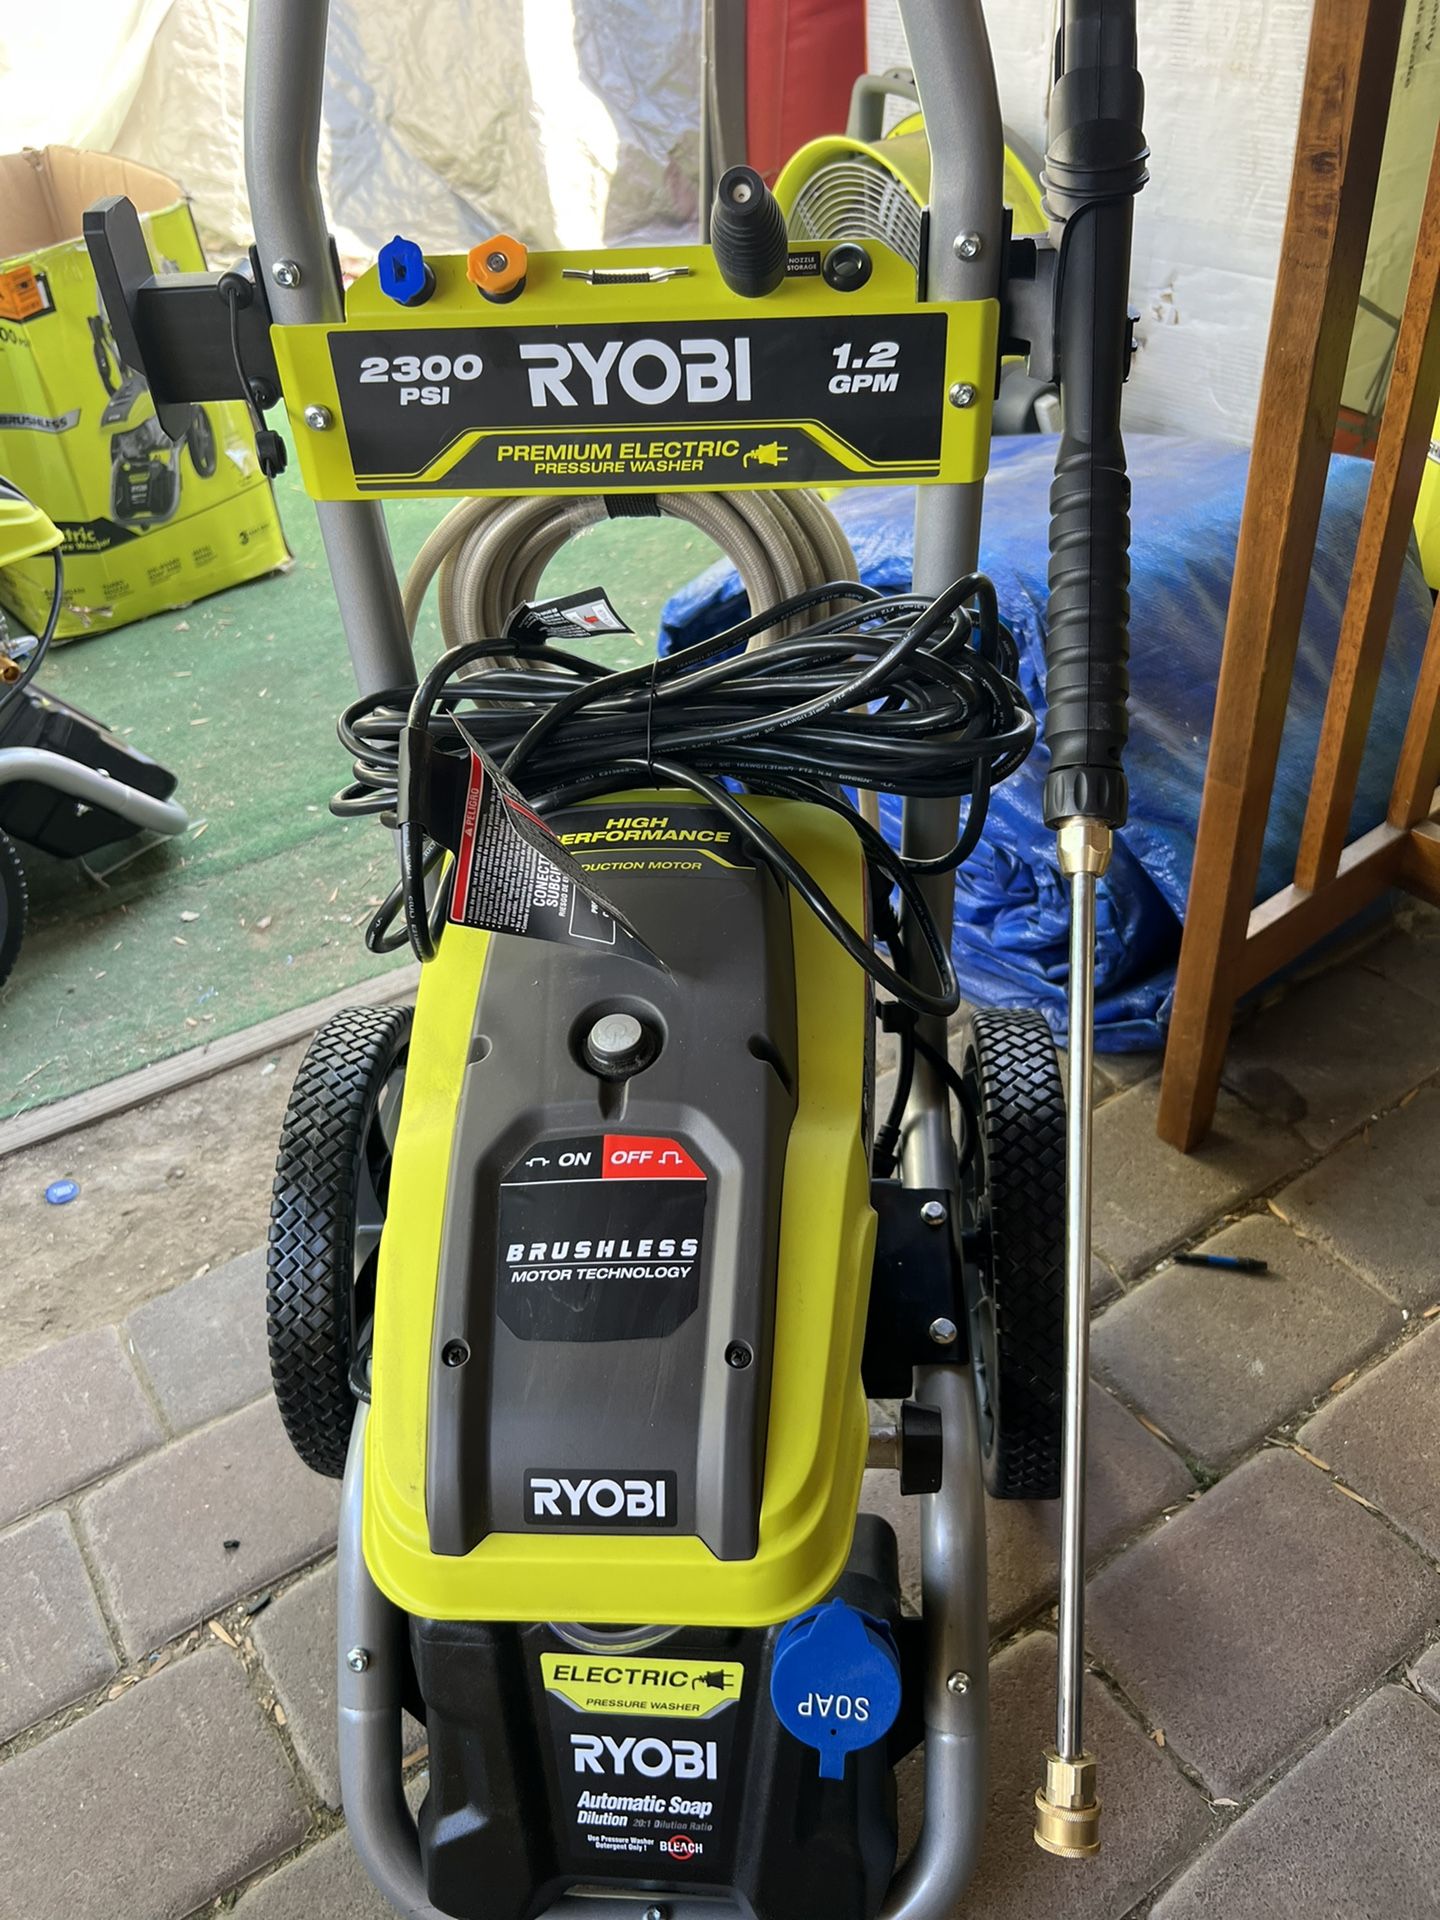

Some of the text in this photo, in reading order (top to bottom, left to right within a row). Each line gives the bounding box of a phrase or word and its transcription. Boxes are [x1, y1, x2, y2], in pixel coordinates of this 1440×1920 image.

[786, 263, 817, 271] STORAGE
[788, 256, 815, 264] NOZZLE
[832, 341, 900, 370] 1.2
[359, 354, 483, 383] 2300
[519, 337, 751, 407] RYOBI
[827, 373, 899, 394] GPM
[400, 386, 450, 406] PSI
[497, 439, 740, 462] PREMIUM ELECTRIC
[534, 459, 704, 474] PRESSURE WASHER
[466, 787, 480, 827] PELIGRO
[605, 817, 669, 829] HIGH
[648, 862, 703, 870] MOTOR
[532, 854, 551, 906] CONECT
[561, 883, 568, 892] DE
[557, 893, 568, 917] RIESGO
[558, 1150, 653, 1167] ON OFF
[506, 1239, 699, 1262] BRUSHLESS
[511, 1266, 692, 1283] MOTOR TECHNOLOGY
[530, 1478, 666, 1517] RYOBI
[553, 1664, 689, 1687] ELECTRIC
[586, 1698, 701, 1712] PRESSURE WASHER
[798, 1693, 869, 1721] SOAP
[570, 1734, 717, 1780] RYOBI
[577, 1790, 713, 1819] Automatic Soap
[577, 1811, 713, 1831] Dilution 20:1 Dilution Ratio
[587, 1834, 655, 1846] Use Pressure Washer
[595, 1842, 627, 1851] Detergent
[628, 1843, 643, 1853] Only
[660, 1841, 703, 1854] BLEACH
